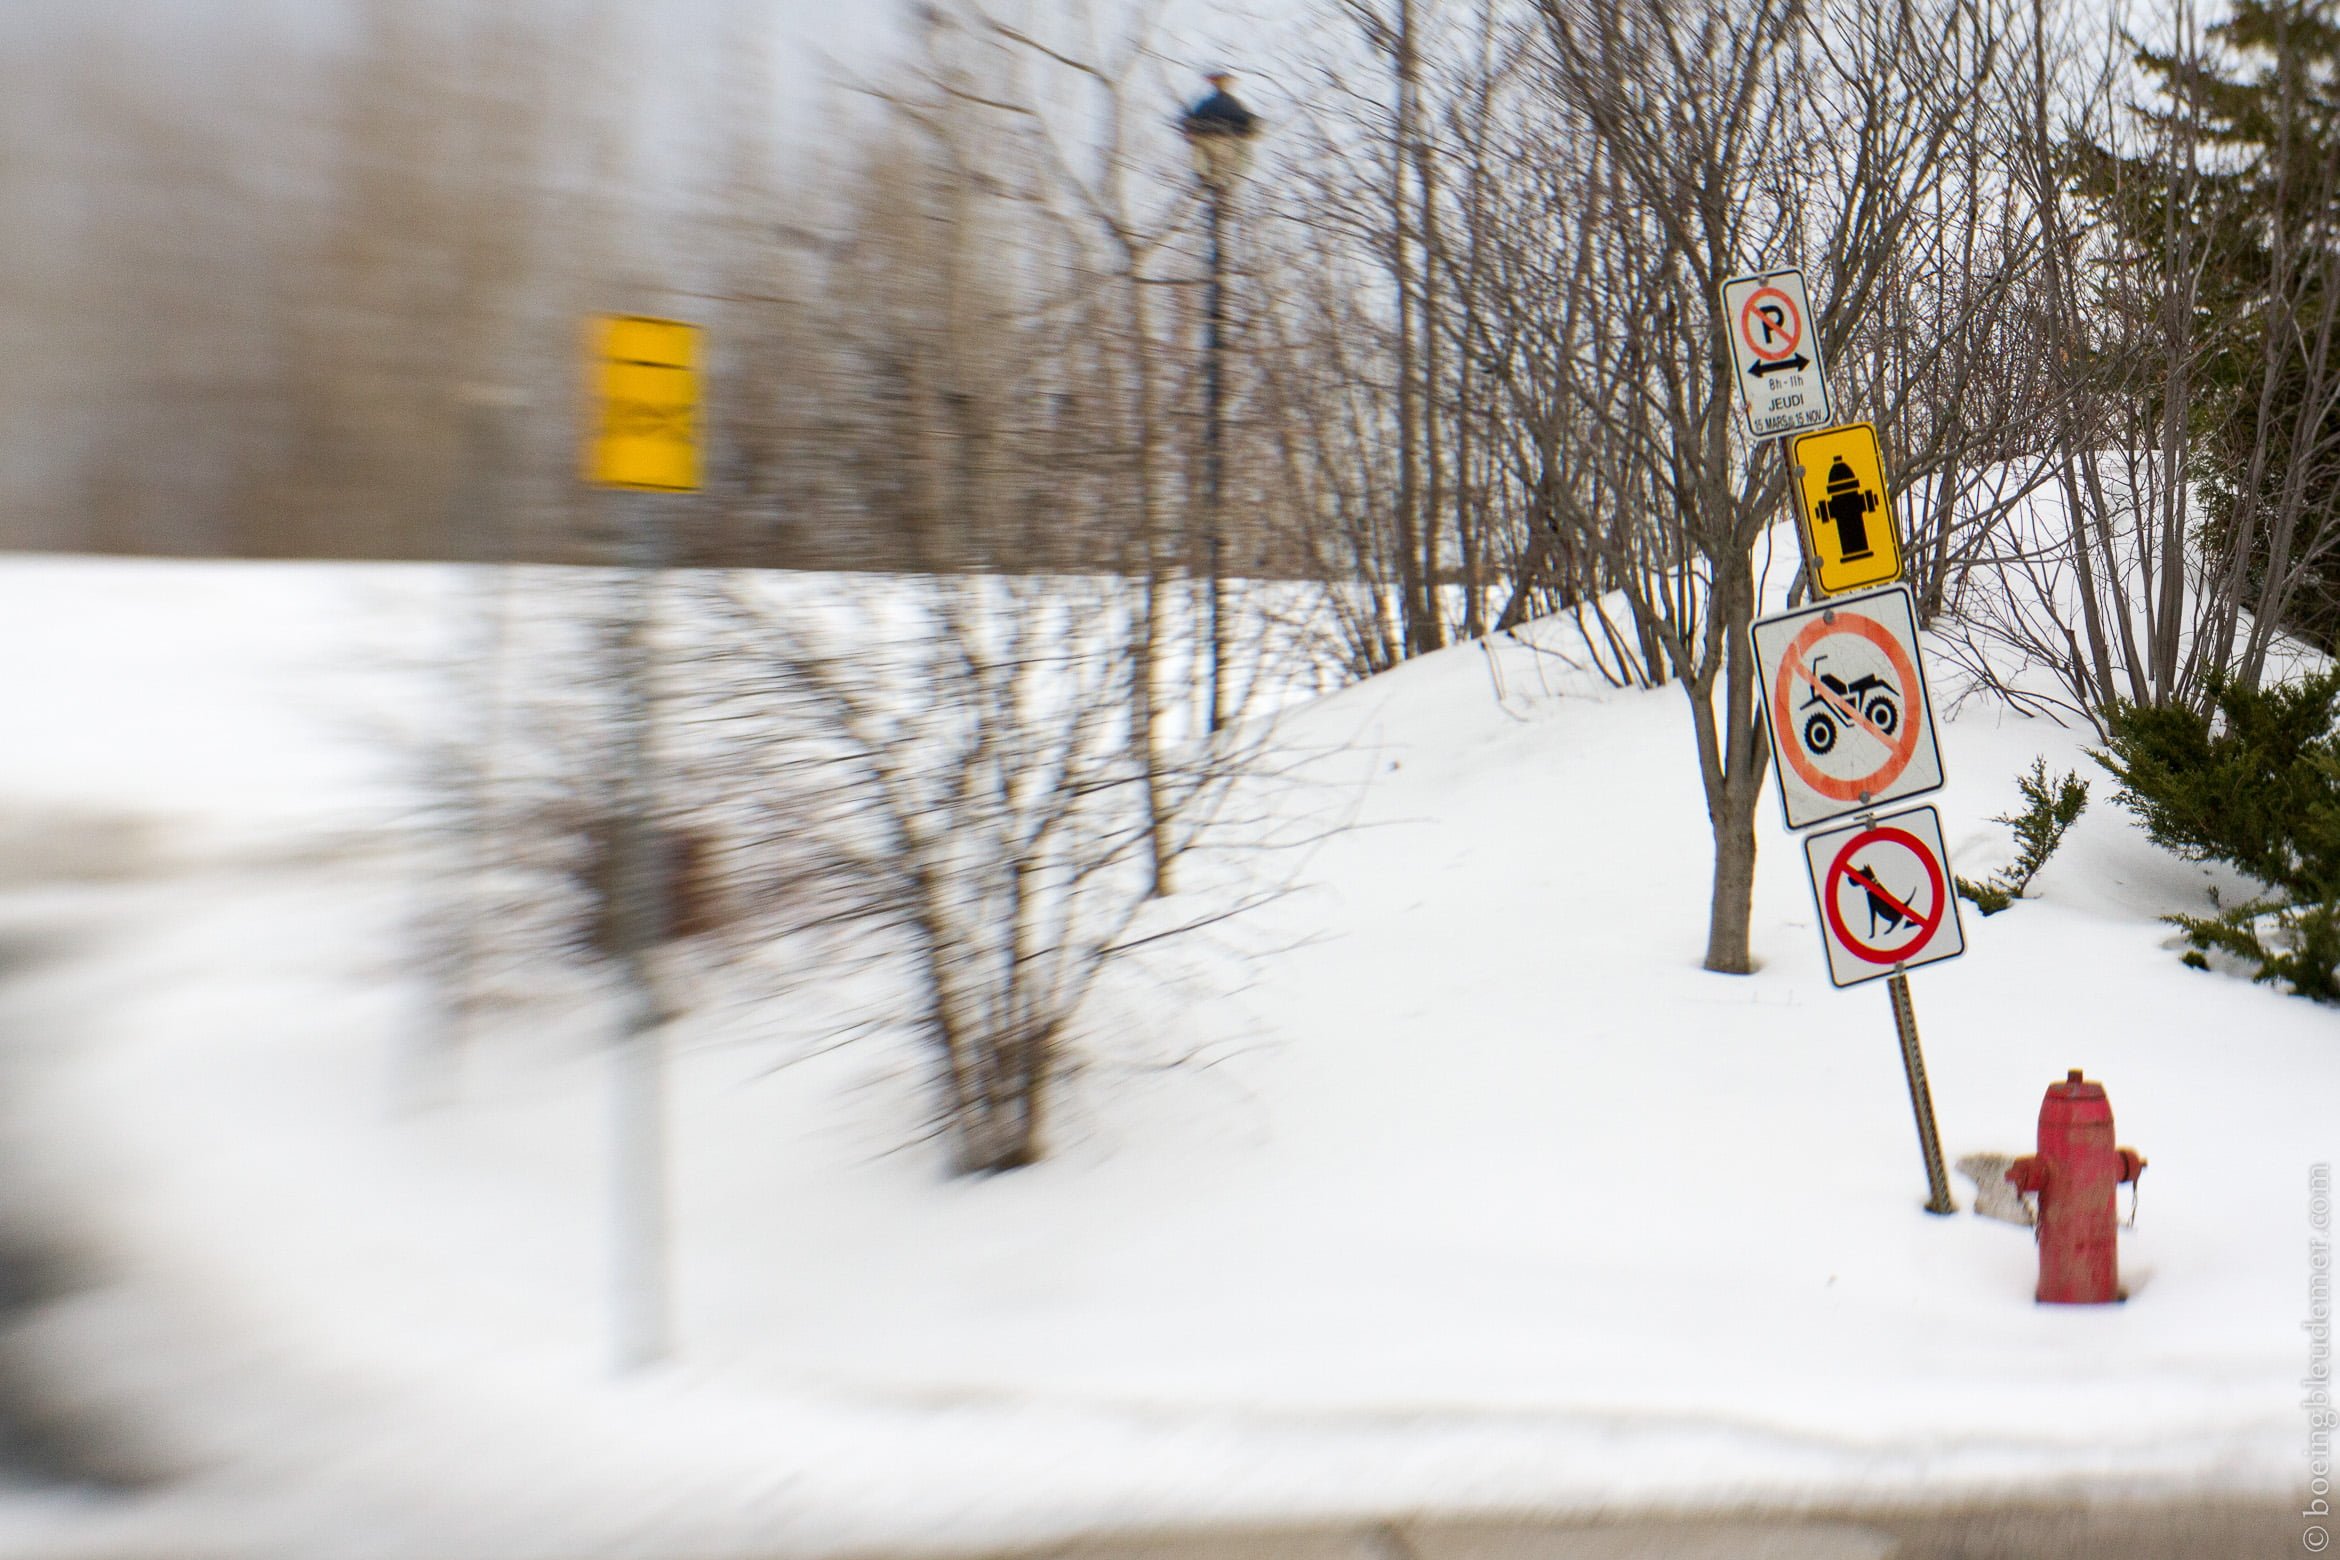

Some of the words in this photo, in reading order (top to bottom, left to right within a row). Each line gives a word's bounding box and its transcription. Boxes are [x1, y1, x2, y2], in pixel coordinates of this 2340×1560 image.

[1759, 305, 1785, 344] P
[1768, 394, 1804, 412] JEUDI
[1765, 414, 1788, 428] MARS
